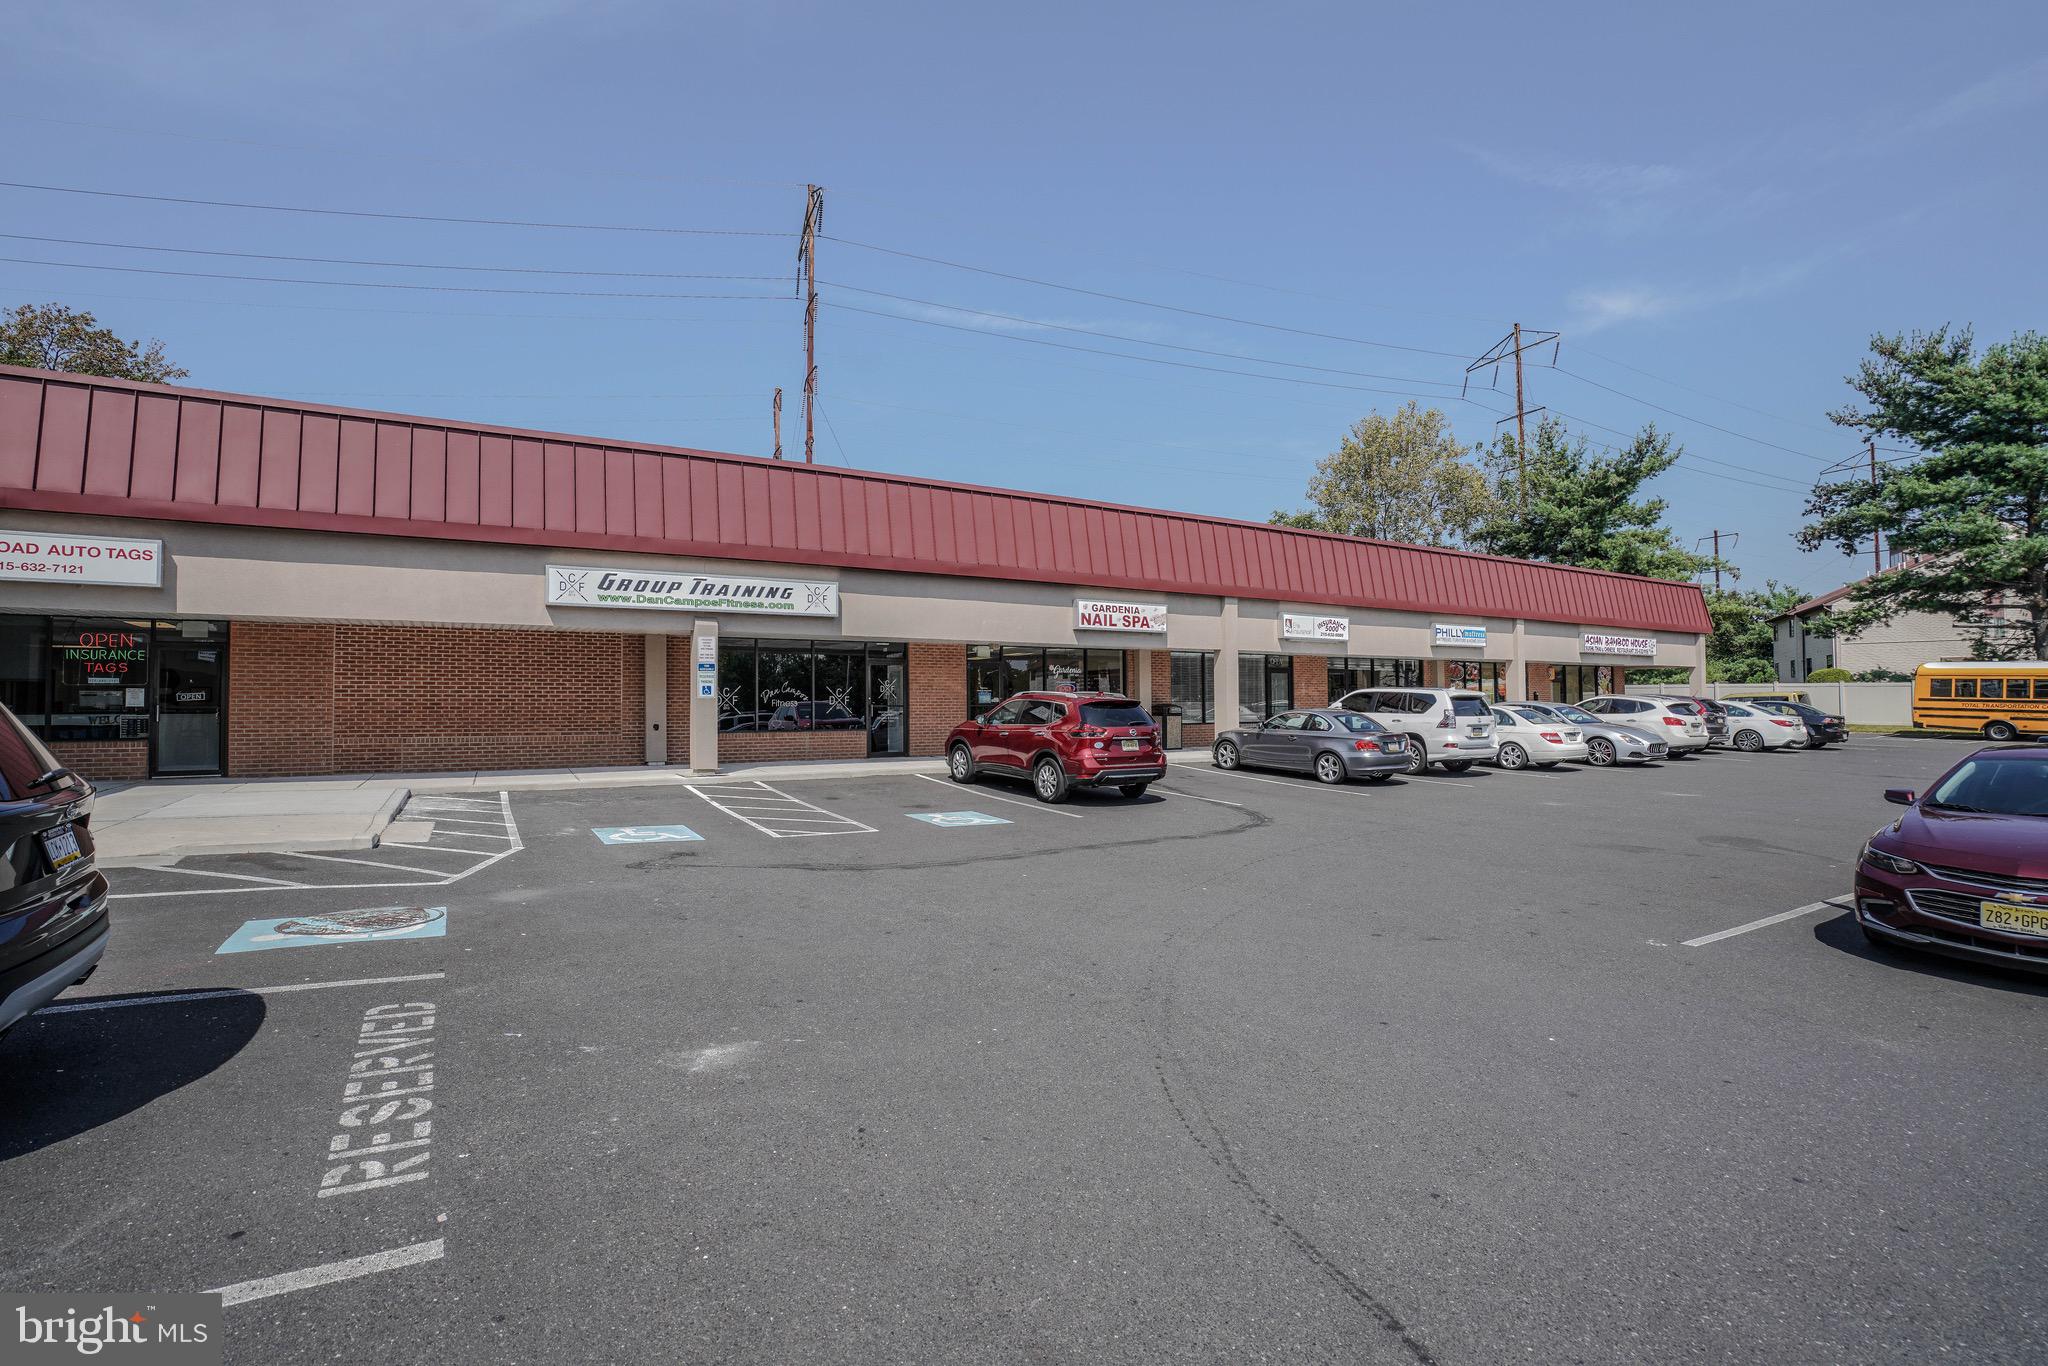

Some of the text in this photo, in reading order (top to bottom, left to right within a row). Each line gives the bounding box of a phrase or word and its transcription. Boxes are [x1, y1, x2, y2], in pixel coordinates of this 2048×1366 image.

[47, 544, 101, 558] AUTO
[105, 547, 154, 561] TAGS
[597, 572, 794, 600] GROUP TRAINING
[1091, 603, 1141, 615] GARDENIA
[1081, 612, 1150, 629] NAIL SPA
[1316, 619, 1346, 632] INSURANCE
[1435, 627, 1465, 638] PHILLY
[79, 633, 134, 648] OPEN
[1585, 635, 1648, 648] ASIAN BAMBOO HOUSE
[64, 648, 146, 660] INSURANCE
[84, 662, 129, 673] TAGS
[180, 693, 202, 701] OPEN
[771, 699, 798, 707] Fitness
[88, 715, 121, 725] WELC
[1986, 909, 2012, 925] Z82
[317, 1002, 436, 1198] RESERVED
